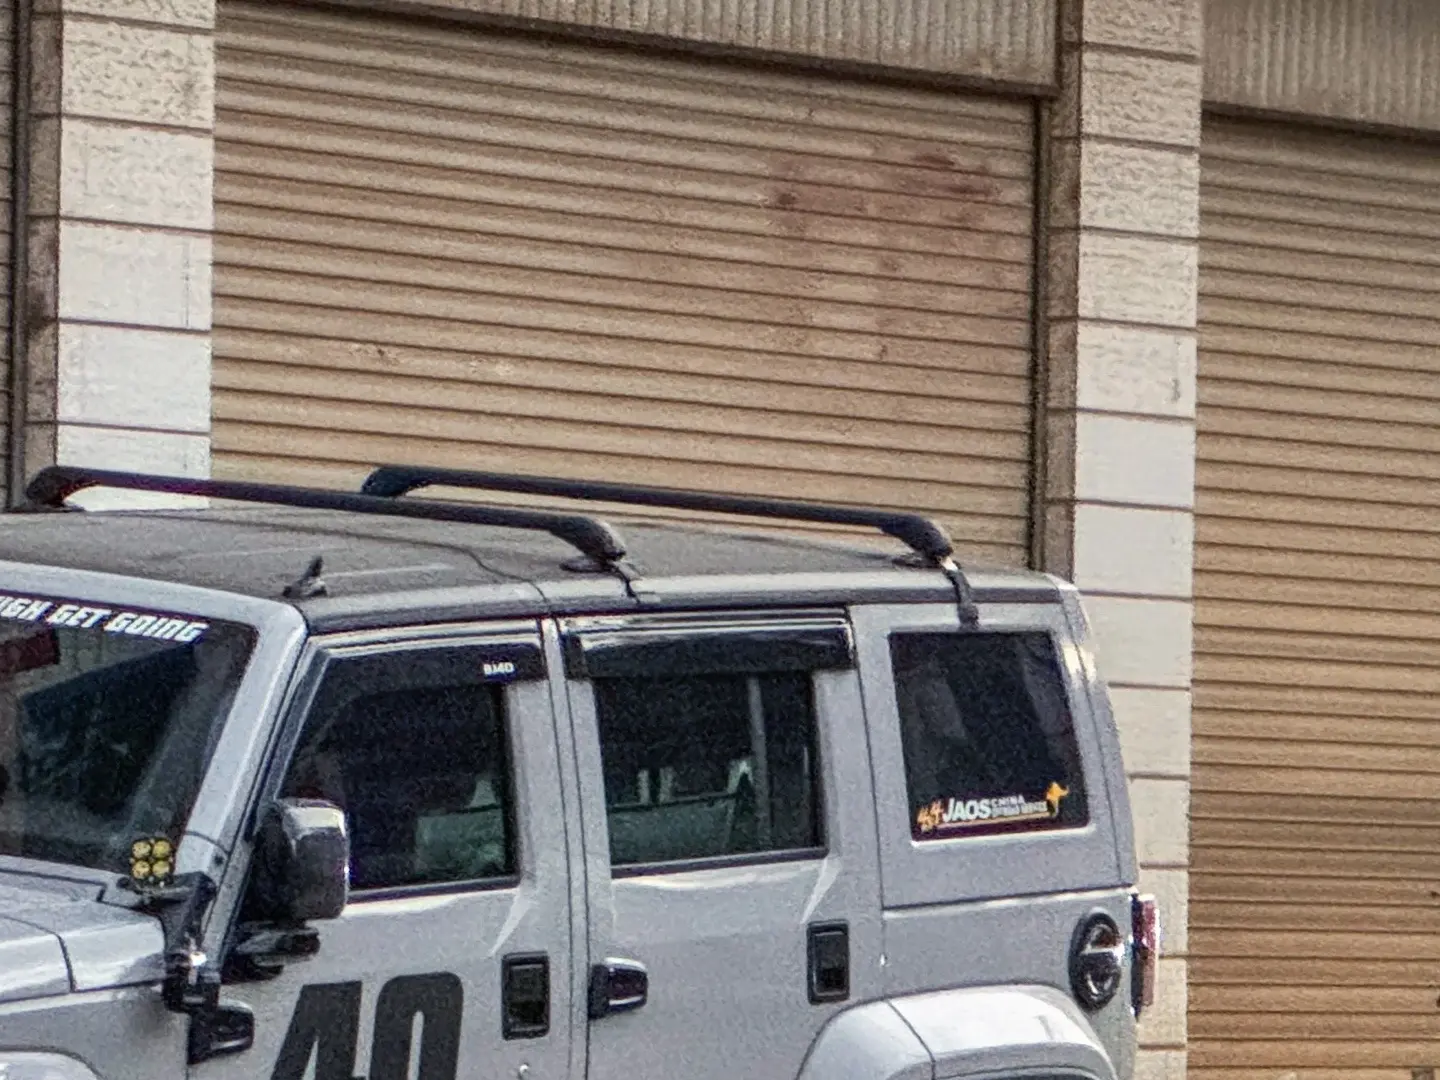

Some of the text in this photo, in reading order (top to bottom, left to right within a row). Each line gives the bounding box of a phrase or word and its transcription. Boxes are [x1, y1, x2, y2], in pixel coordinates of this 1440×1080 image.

[47, 604, 111, 628] GET
[104, 612, 209, 642] GOING
[942, 797, 991, 823] JAOS
